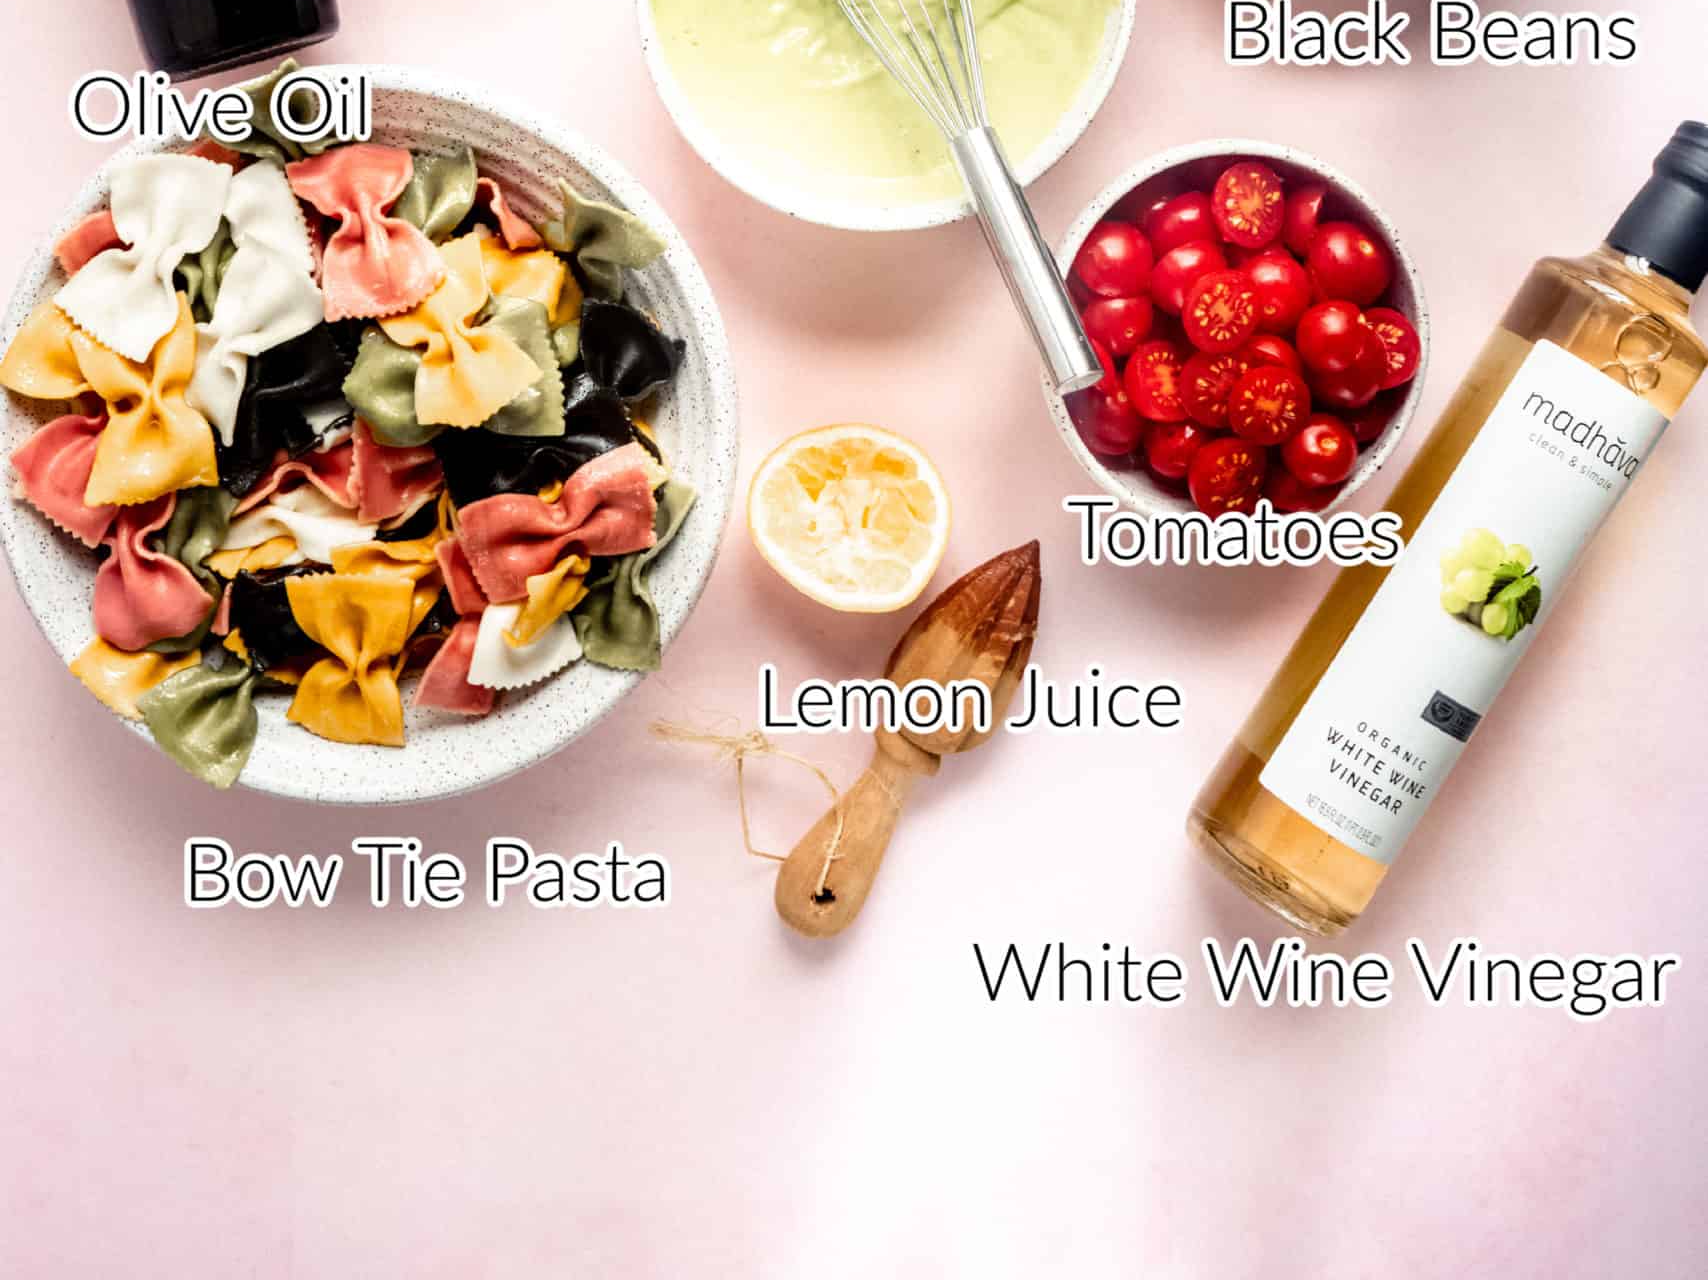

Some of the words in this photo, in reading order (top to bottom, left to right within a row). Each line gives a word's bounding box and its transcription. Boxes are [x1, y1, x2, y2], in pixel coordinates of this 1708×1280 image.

[1528, 431, 1565, 460] clean
[1568, 455, 1578, 468] &
[1580, 465, 1613, 491] simple
[1326, 726, 1385, 775] WHITE
[1389, 767, 1427, 800] WINE
[1356, 721, 1427, 772] ORGANIC
[1329, 758, 1403, 815] VINEGAR
